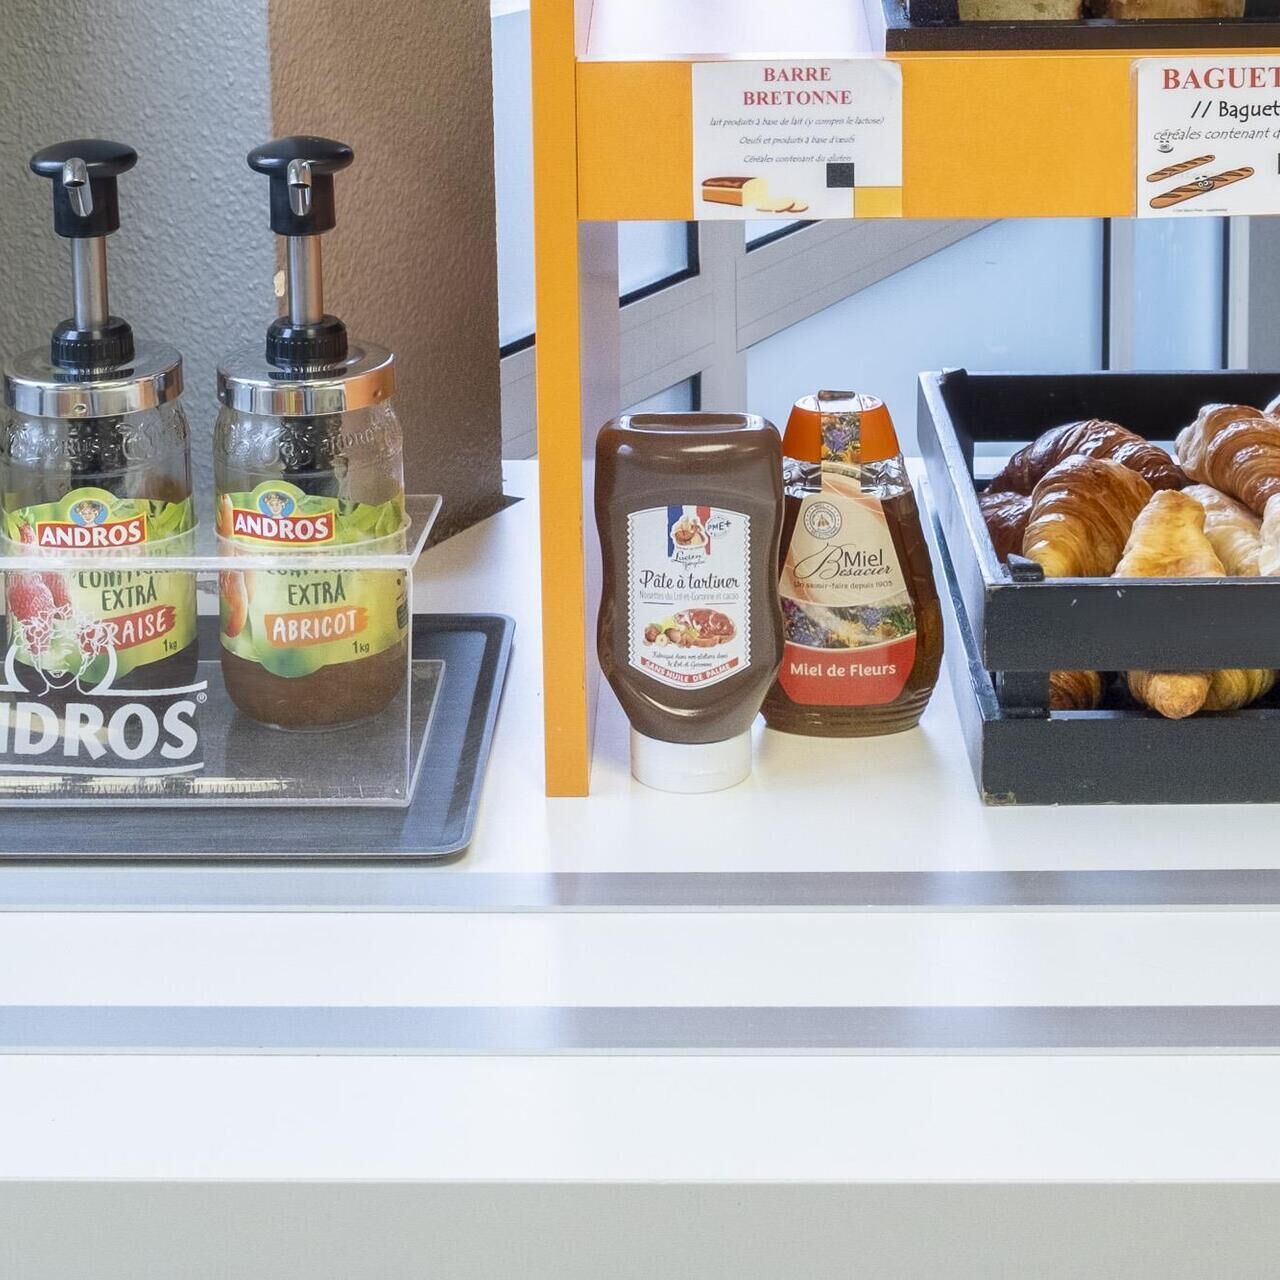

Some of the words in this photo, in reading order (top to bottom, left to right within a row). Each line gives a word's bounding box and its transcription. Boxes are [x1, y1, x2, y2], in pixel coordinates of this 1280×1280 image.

[763, 67, 831, 82] BARRE
[743, 90, 853, 106] BRETONNE
[1153, 126, 1201, 140] céréales
[1204, 127, 1270, 140] contenant
[40, 521, 141, 546] ANDROS
[235, 513, 329, 540] ANDROS
[793, 542, 891, 580] Besacier
[844, 549, 883, 568] Miel
[288, 573, 346, 606] EXTRA
[640, 570, 674, 589] Pâte
[676, 575, 685, 589] à
[687, 573, 740, 589] tartiner
[102, 576, 157, 611] EXTRA
[99, 608, 167, 646] RAISE
[273, 609, 357, 643] ABRICOT
[791, 663, 822, 676] Miel
[827, 663, 845, 677] de
[850, 663, 896, 676] Fleurs
